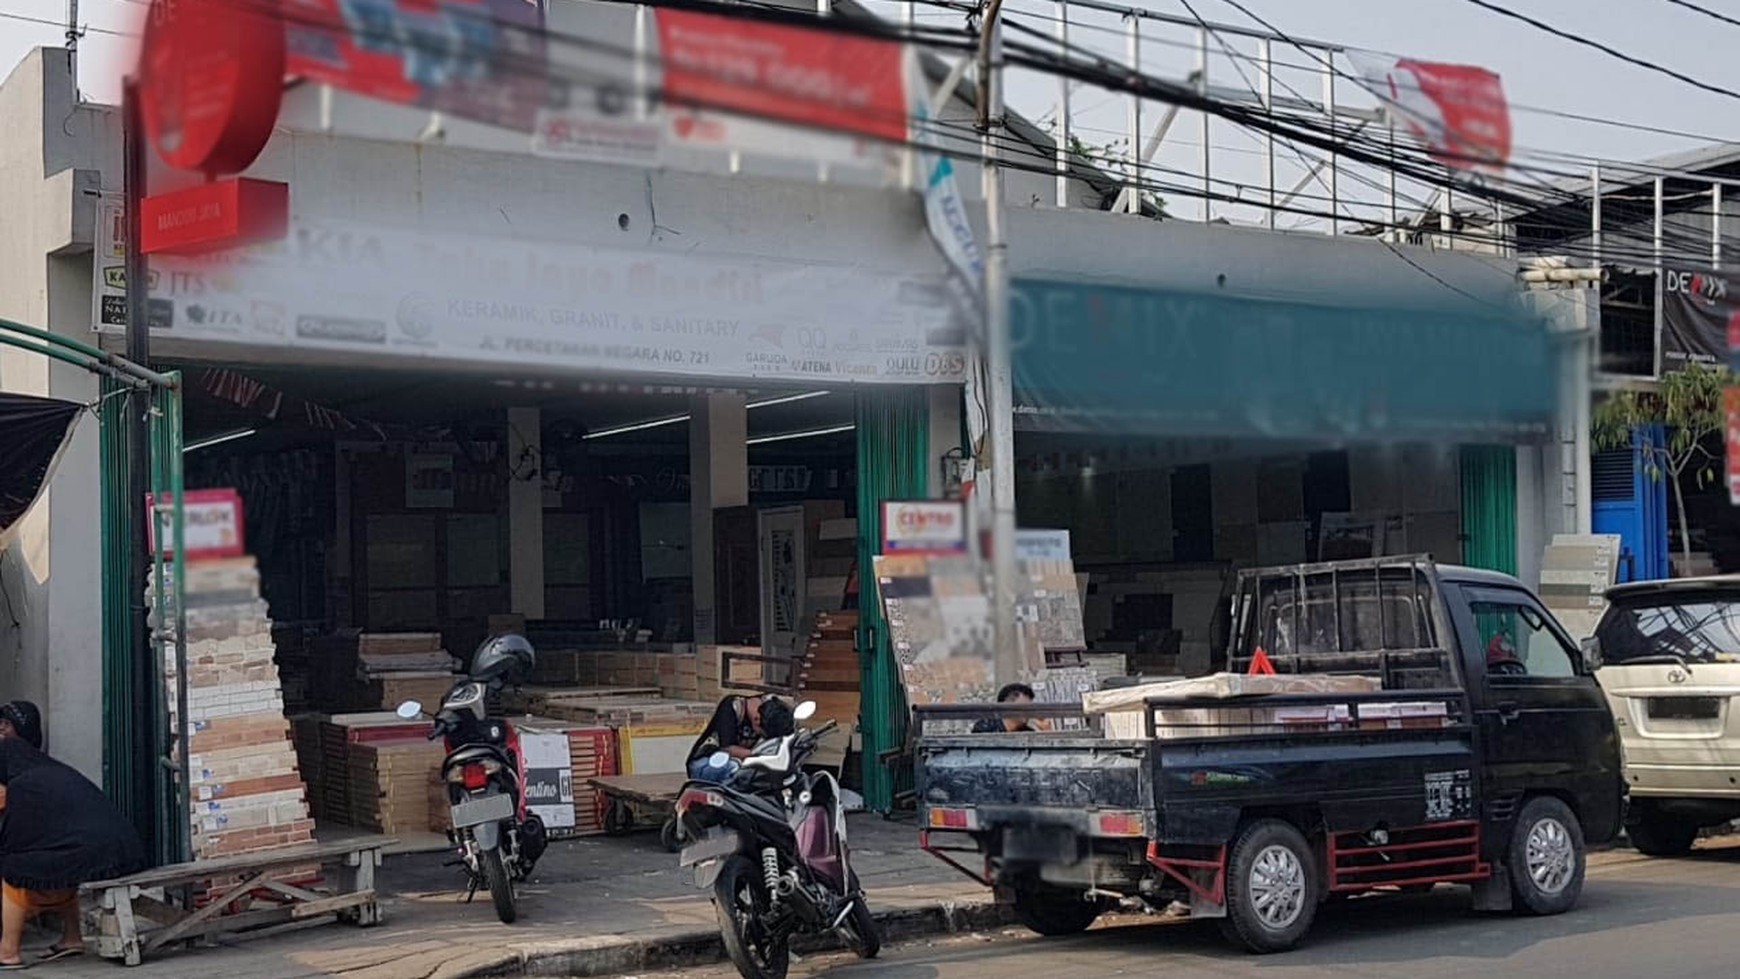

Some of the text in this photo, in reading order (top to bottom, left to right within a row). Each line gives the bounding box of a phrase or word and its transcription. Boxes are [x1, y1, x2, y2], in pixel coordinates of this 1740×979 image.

[549, 308, 626, 331] GRANIT,
[651, 318, 741, 338] SANITARY
[663, 349, 684, 363] NO.
[689, 351, 709, 365] 721
[745, 352, 787, 365] GARUDA
